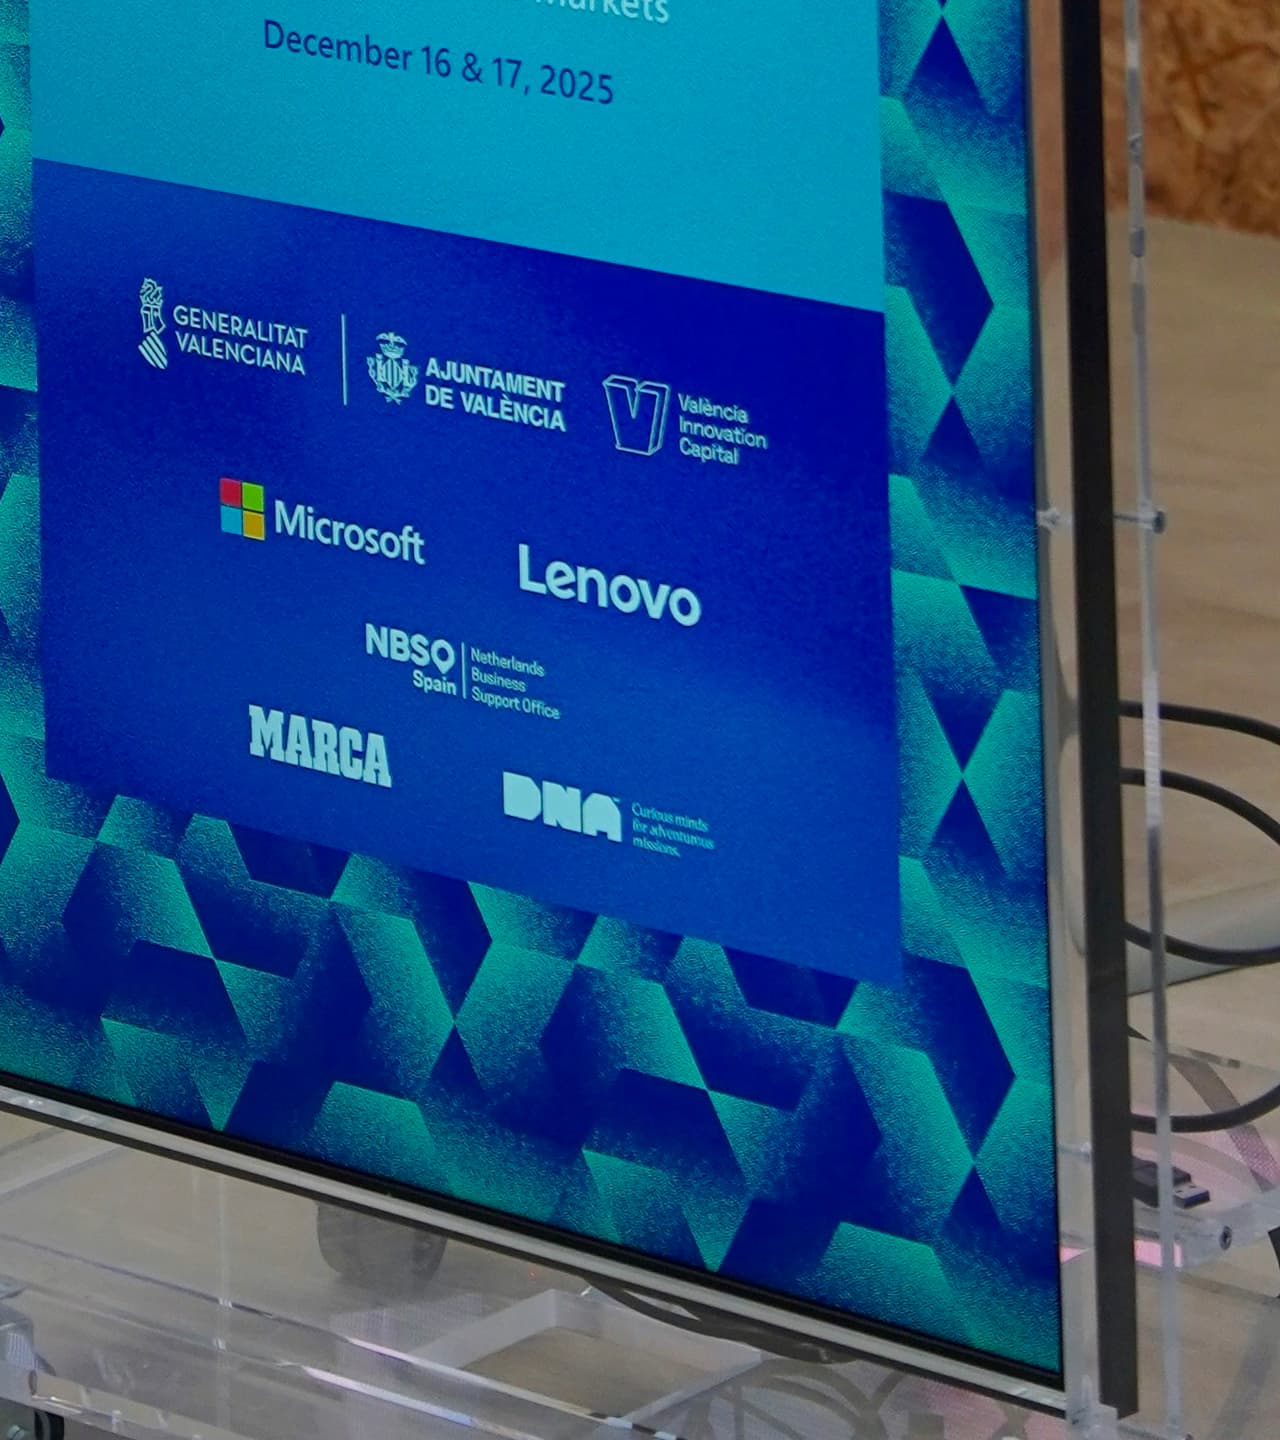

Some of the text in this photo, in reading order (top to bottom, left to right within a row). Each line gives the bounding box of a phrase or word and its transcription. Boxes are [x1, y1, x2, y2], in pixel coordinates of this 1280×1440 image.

[264, 19, 614, 105] December 16 & 17, 2025
[173, 305, 307, 348] GENERALITAT
[175, 331, 306, 375] VALENCIANA
[425, 357, 565, 403] AJUNTAMENT
[425, 384, 566, 432] DE VALÈNCIA
[679, 415, 768, 449] Innovation
[679, 437, 738, 464] Capital
[274, 499, 425, 565] Microsoft
[519, 543, 702, 628] Lenovo
[365, 623, 455, 674] NBSO
[471, 646, 545, 677] Netherlands
[412, 669, 457, 695] Spain
[471, 667, 527, 692] Business
[471, 686, 561, 720] Support Office
[248, 704, 392, 788] MARCA
